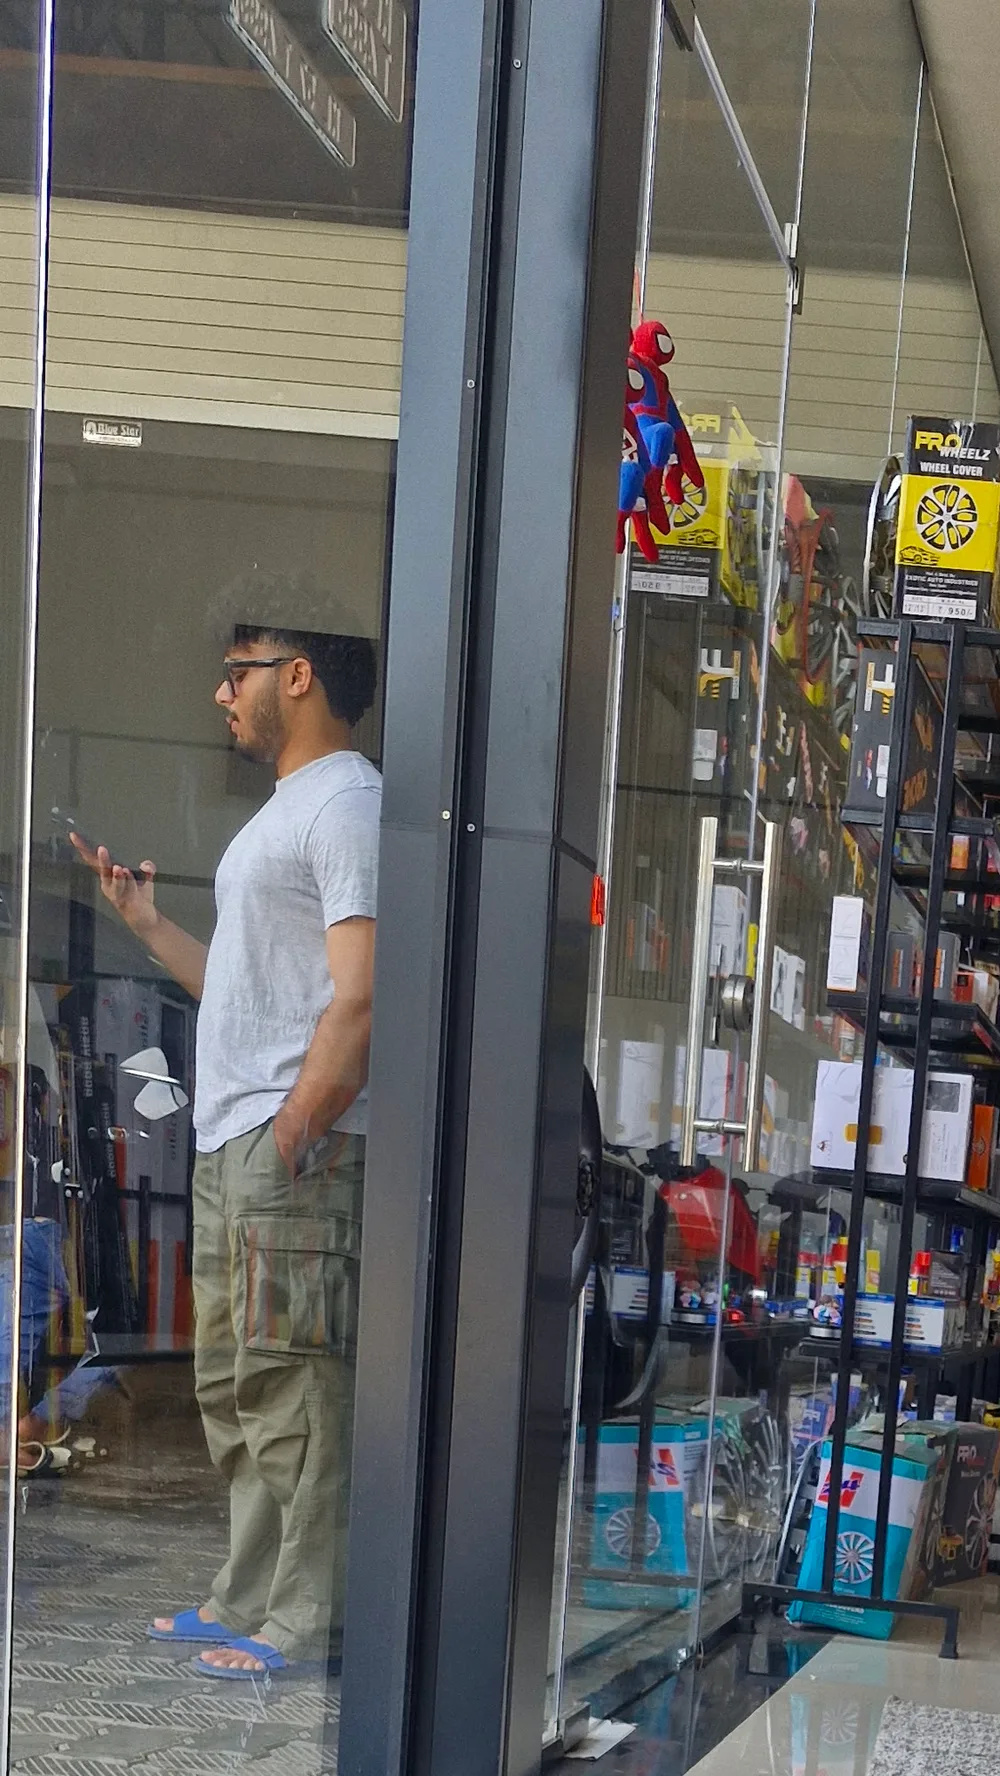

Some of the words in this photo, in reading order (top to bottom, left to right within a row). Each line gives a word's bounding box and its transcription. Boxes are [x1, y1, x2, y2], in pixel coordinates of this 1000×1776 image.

[98, 423, 119, 435] Blue
[120, 424, 140, 436] Star
[915, 430, 962, 451] PRO
[940, 446, 991, 461] WHEELZ
[920, 462, 951, 473] WHEEL
[953, 465, 983, 476] COVER
